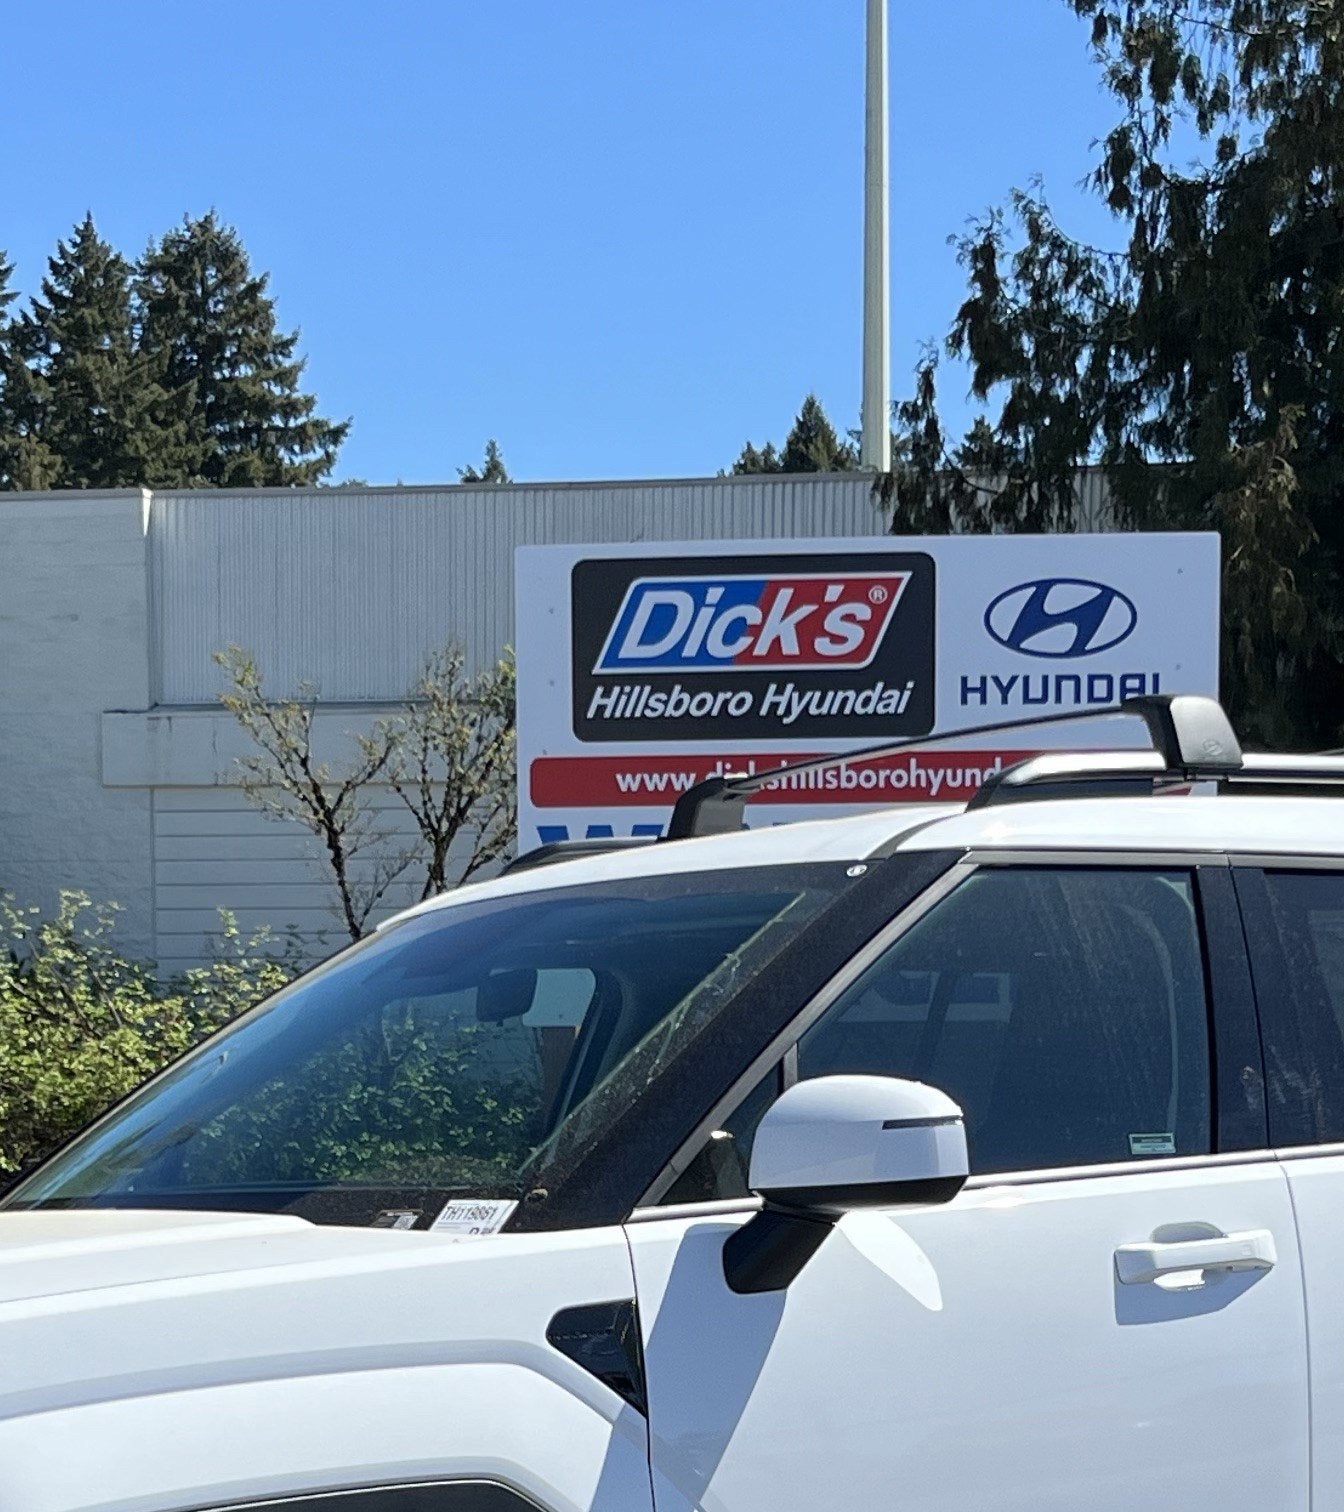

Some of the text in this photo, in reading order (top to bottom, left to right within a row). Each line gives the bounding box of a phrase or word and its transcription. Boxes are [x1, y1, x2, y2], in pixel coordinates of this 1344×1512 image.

[587, 681, 915, 725] Hillsboro Hyundai
[960, 672, 1160, 706] HYUNDAI
